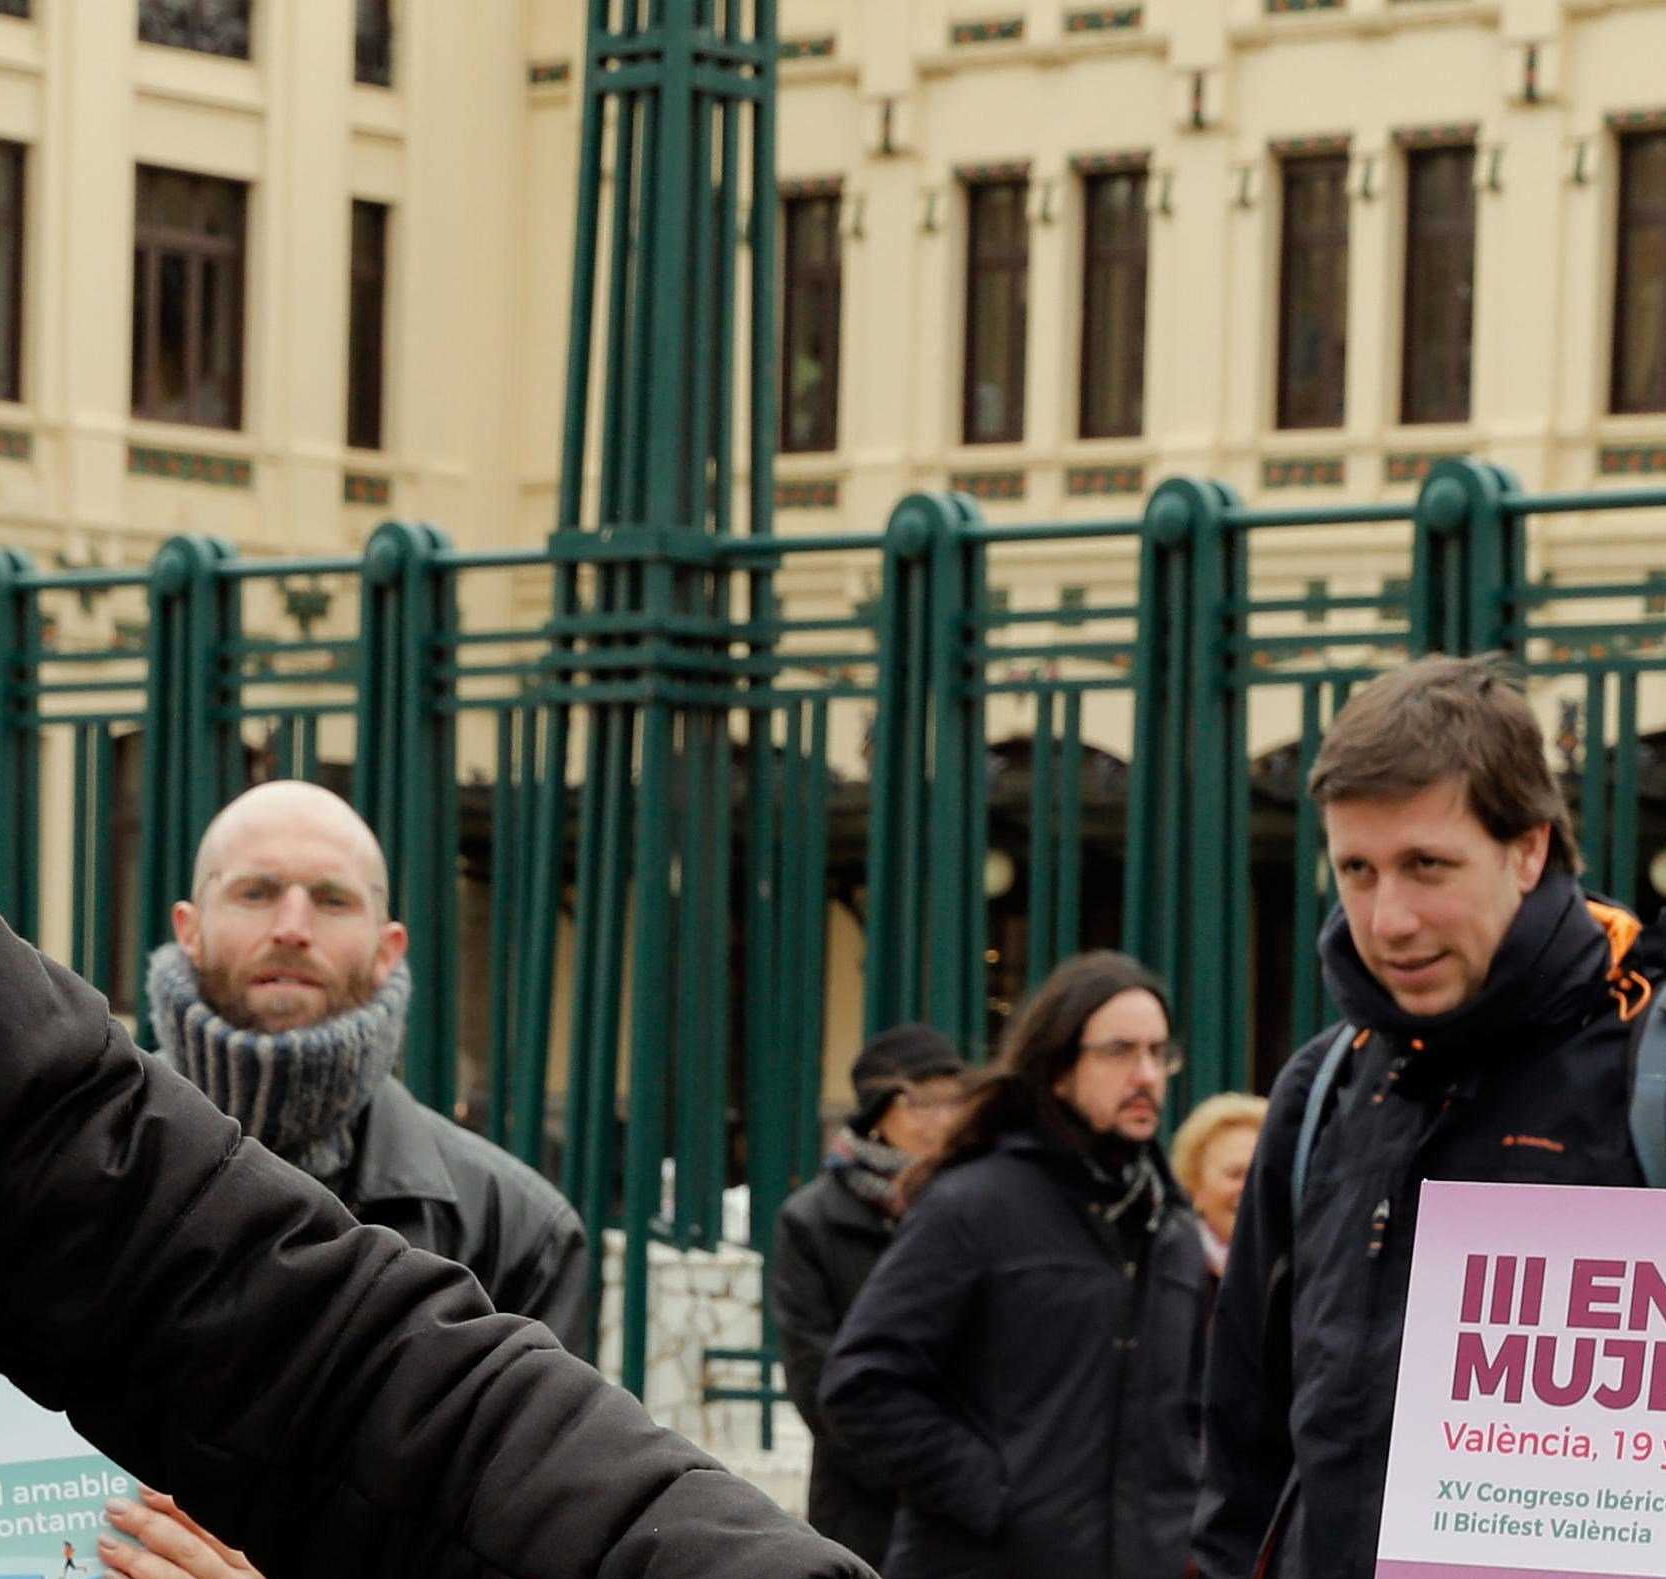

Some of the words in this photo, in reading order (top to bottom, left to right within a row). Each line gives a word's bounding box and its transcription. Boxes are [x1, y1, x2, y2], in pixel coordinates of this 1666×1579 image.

[1459, 1253, 1547, 1327] III
[1443, 1421, 1598, 1462] València,
[1613, 1430, 1653, 1462] 19
[12, 1471, 128, 1503] amable
[1436, 1479, 1472, 1501] XV
[1476, 1482, 1590, 1510] Congreso
[1433, 1511, 1448, 1532] II
[1453, 1511, 1544, 1537] Bicifest
[1550, 1518, 1652, 1544] València
